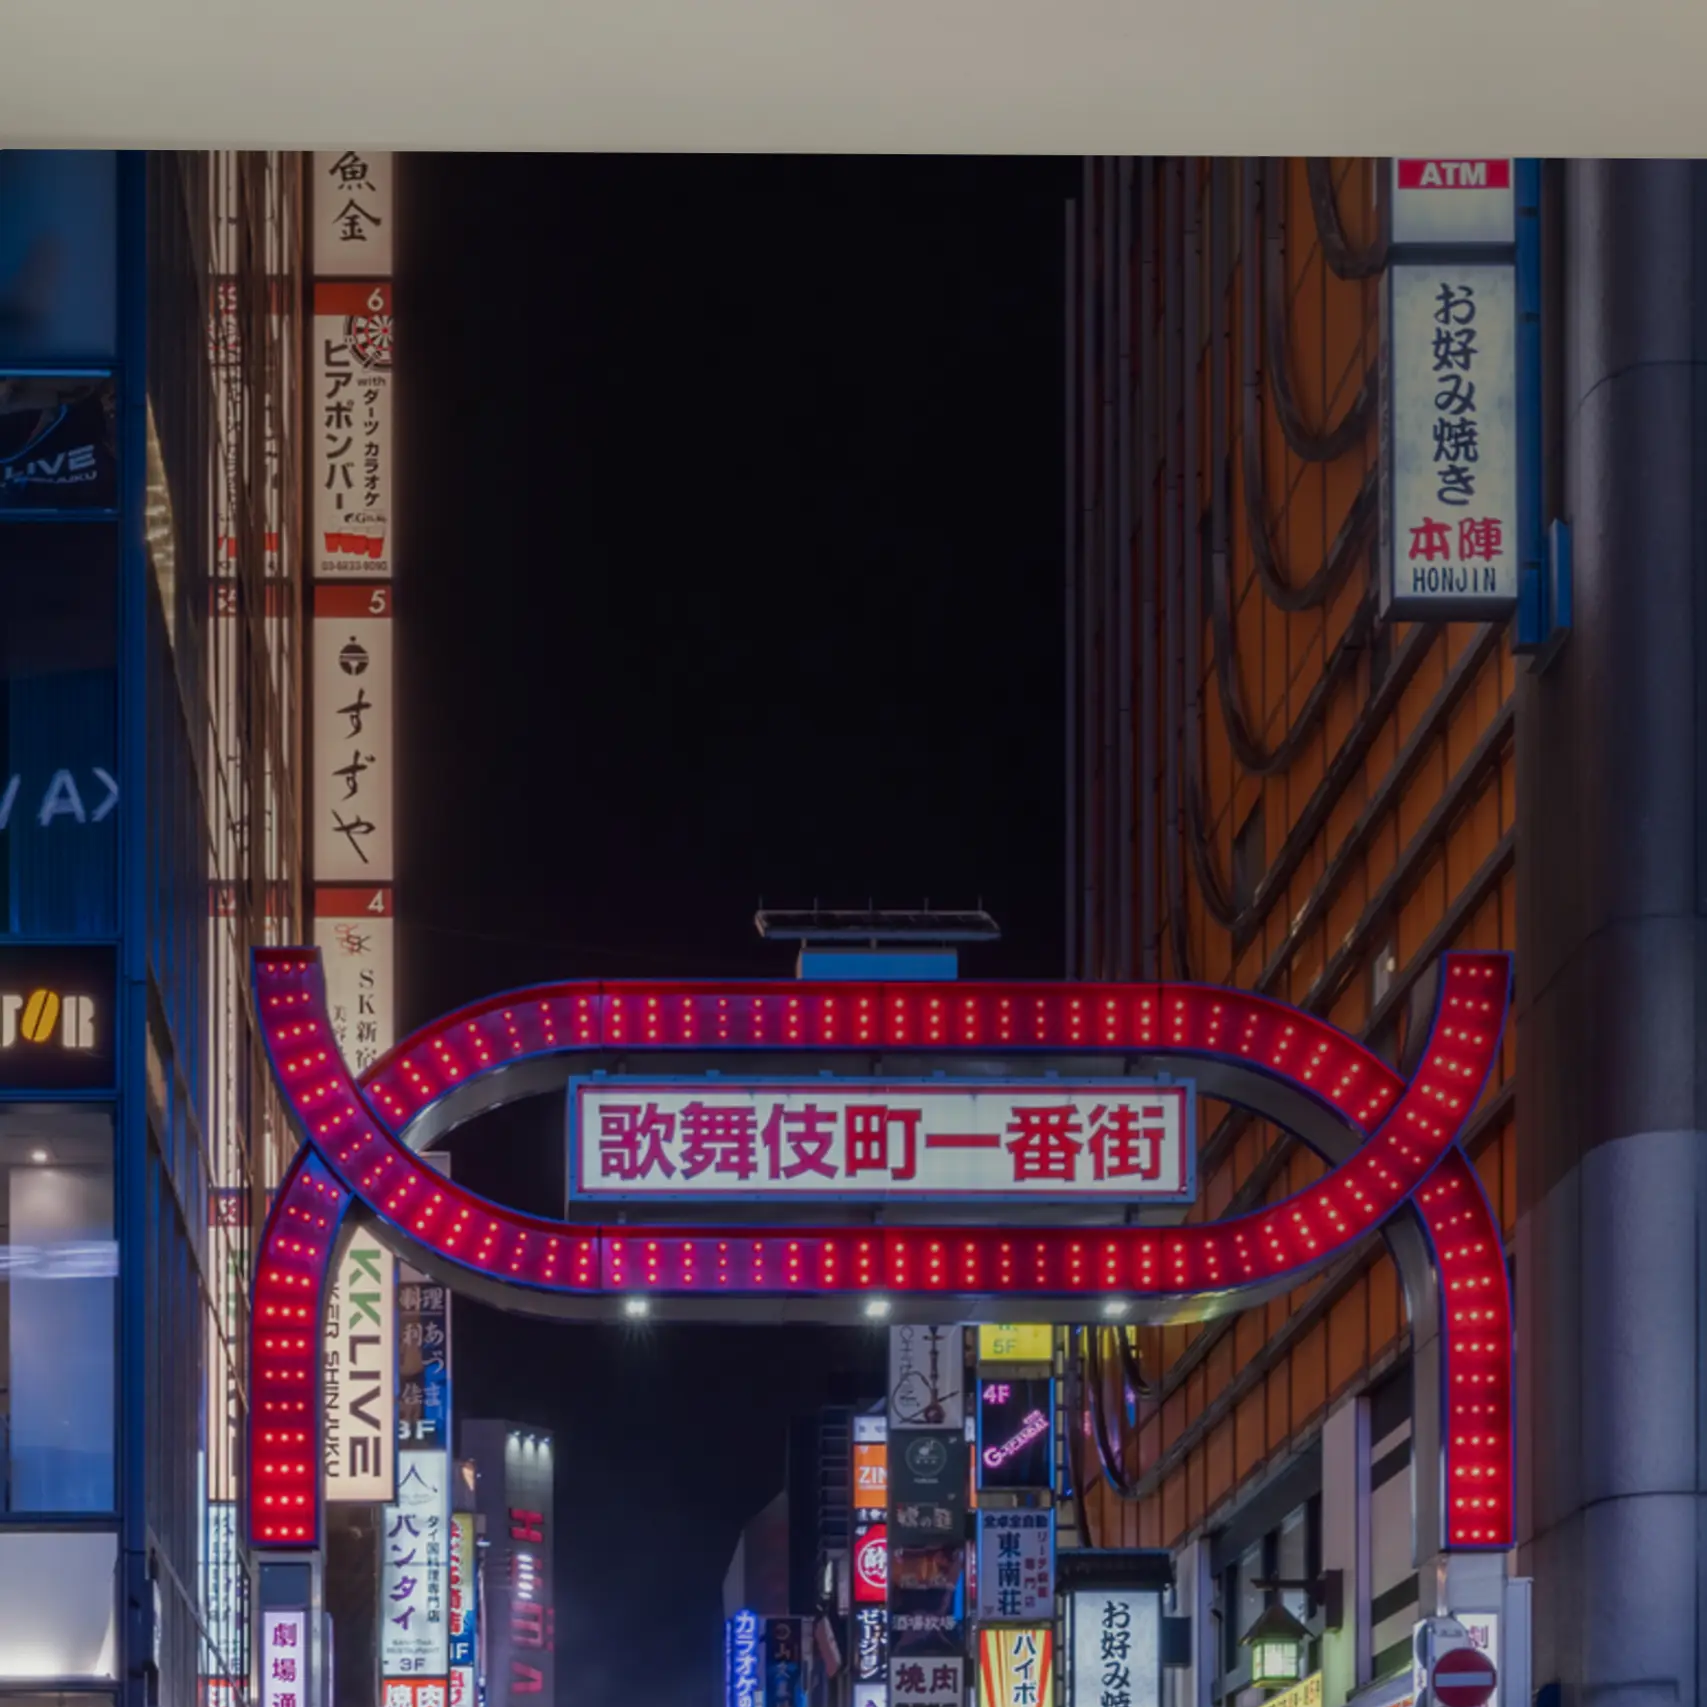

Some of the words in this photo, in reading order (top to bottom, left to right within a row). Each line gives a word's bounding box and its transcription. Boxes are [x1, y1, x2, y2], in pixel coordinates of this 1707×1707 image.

[329, 151, 382, 242] 魚金
[1419, 162, 1488, 187] ATM
[366, 288, 385, 312] 6
[357, 376, 387, 388] with
[1432, 282, 1480, 506] お好み焼き
[363, 389, 380, 436] ダーツ
[363, 441, 380, 507] カラオケ
[1408, 515, 1504, 563] 本陣
[368, 588, 386, 614] 5
[1412, 566, 1497, 593] HONJIN
[331, 688, 377, 864] すずや
[366, 889, 386, 914] 4
[598, 1101, 1166, 1184] 歌舞伎町一番街
[349, 1249, 382, 1478] KKLIVE
[992, 1340, 1018, 1355] 5F
[982, 1384, 1011, 1405] 4F
[388, 1513, 420, 1630] バンタイ
[997, 1530, 1022, 1616] 東南荘
[400, 1657, 426, 1672] 3F
